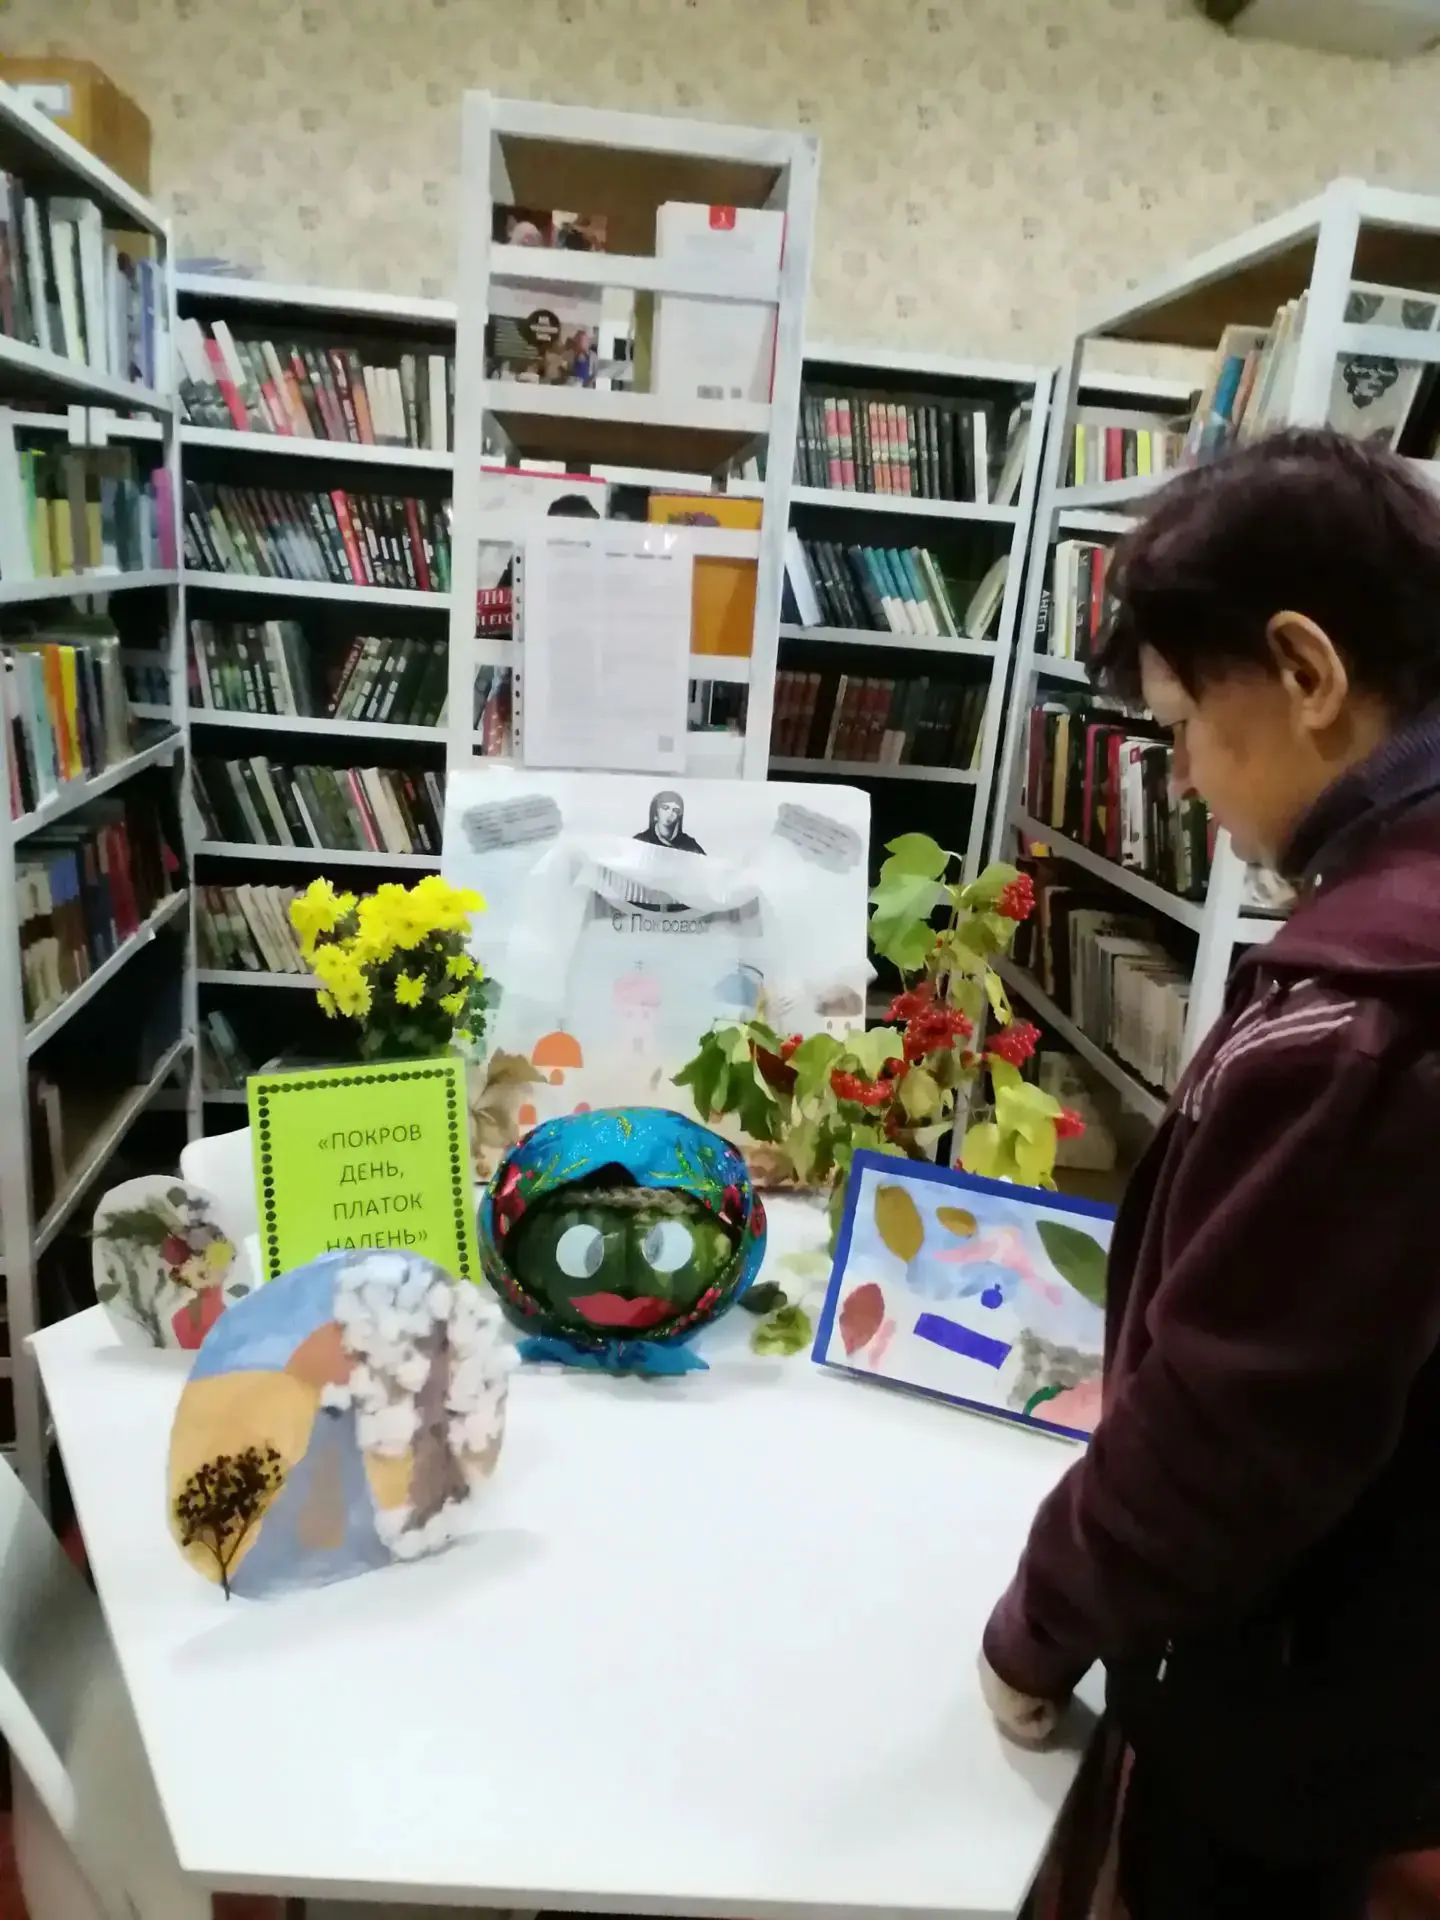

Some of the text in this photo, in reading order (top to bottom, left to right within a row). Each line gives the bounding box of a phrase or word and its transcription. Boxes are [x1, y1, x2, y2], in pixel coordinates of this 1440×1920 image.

[318, 1124, 422, 1150] «ПОКРОВ
[340, 1161, 404, 1186] ДЕНЬ,
[333, 1194, 423, 1221] ПЛАТОК
